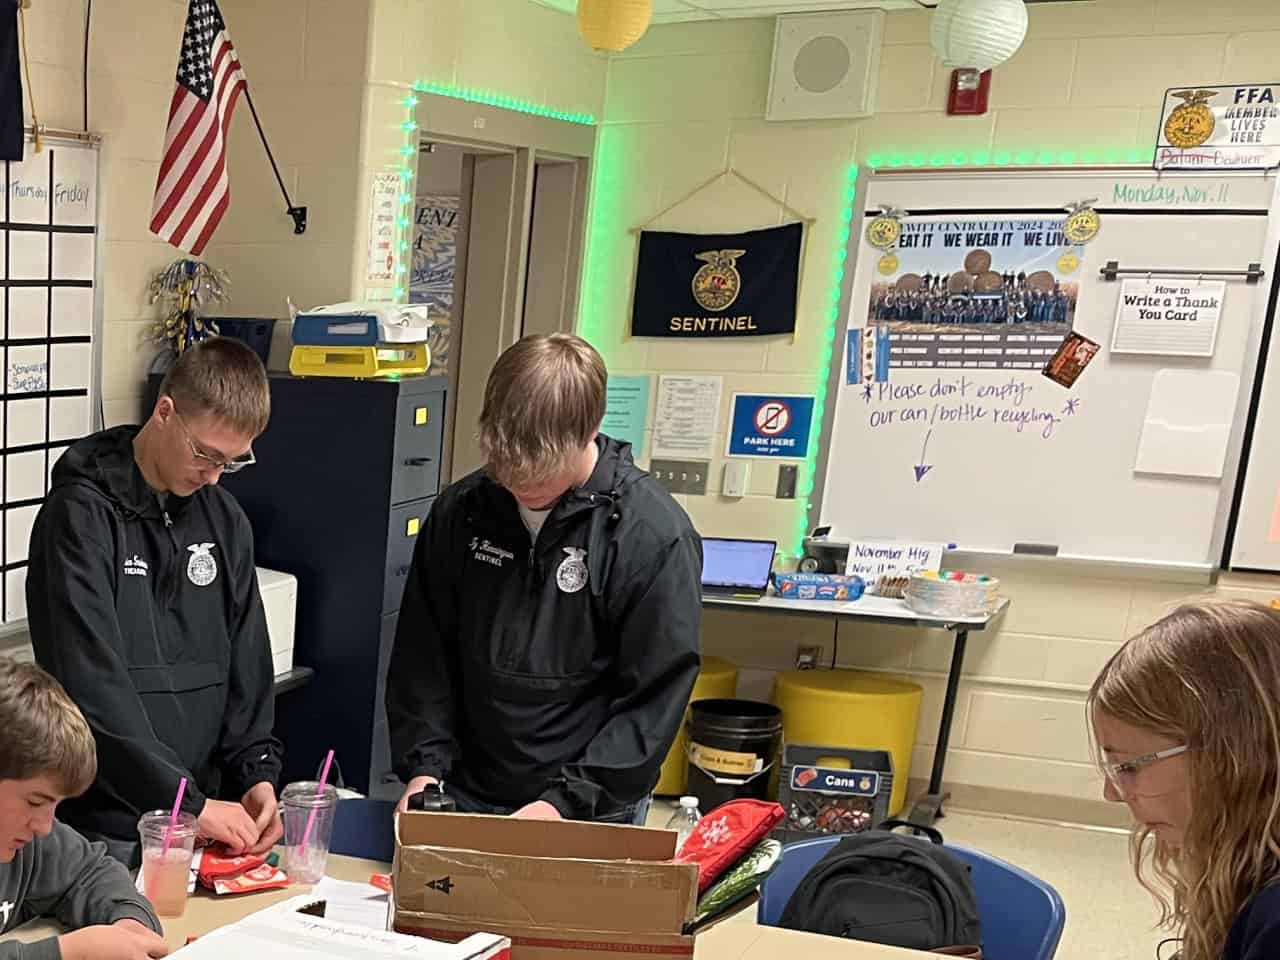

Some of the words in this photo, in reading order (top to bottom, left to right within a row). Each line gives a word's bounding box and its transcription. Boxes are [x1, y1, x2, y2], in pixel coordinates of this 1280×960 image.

[1234, 88, 1274, 104] FFA
[1231, 120, 1265, 131] LIVES
[1230, 132, 1262, 143] HERE
[55, 183, 89, 208] Friday
[899, 234, 920, 248] EAT
[922, 234, 934, 248] IT
[944, 233, 963, 248] WE
[965, 233, 1002, 248] WEAR
[1003, 233, 1014, 247] IT
[1024, 232, 1043, 247] WE
[1154, 285, 1178, 295] How
[1180, 286, 1191, 295] to
[1124, 295, 1160, 307] Write
[1163, 299, 1171, 307] a
[1175, 296, 1219, 308] Thank
[1139, 309, 1162, 320] You
[1165, 310, 1198, 321] Card
[670, 315, 757, 333] SENTINEL
[879, 382, 924, 401] Please
[930, 376, 970, 398] don't
[855, 544, 902, 560] November
[825, 775, 855, 789] Cans
